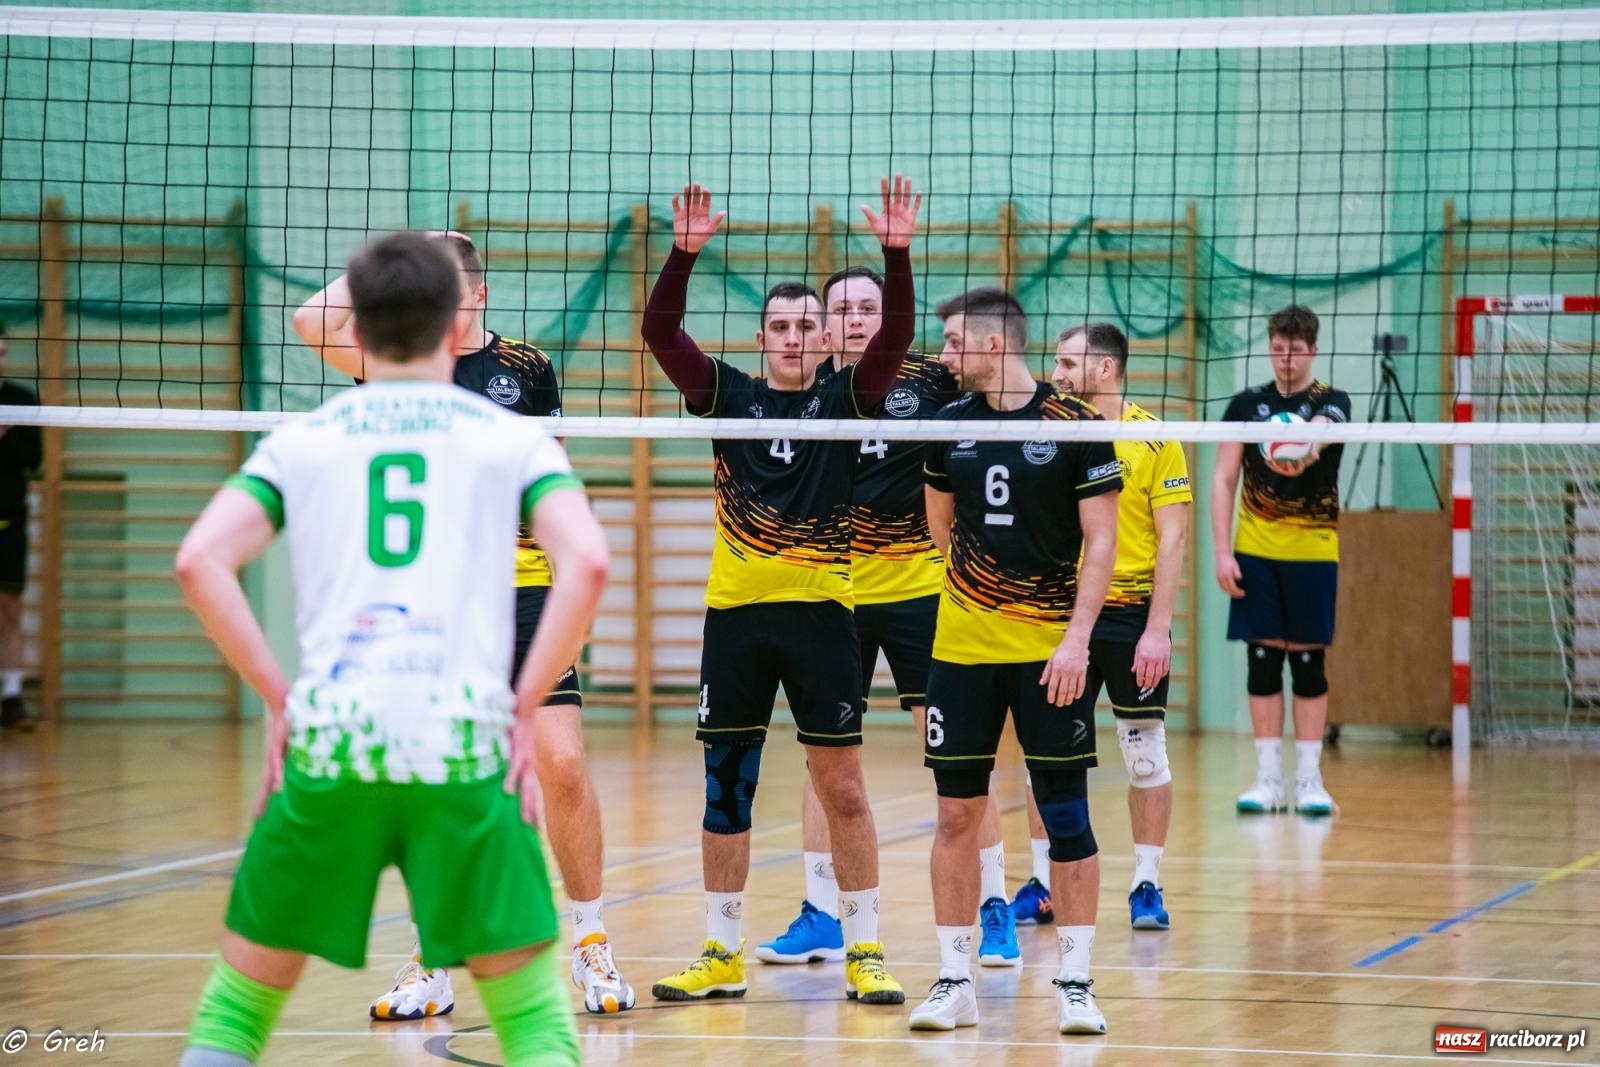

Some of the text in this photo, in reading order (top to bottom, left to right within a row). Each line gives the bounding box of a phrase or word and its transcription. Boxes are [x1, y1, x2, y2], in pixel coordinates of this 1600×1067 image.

[495, 386, 514, 394] TALENT
[892, 399, 913, 407] TALENT
[769, 438, 795, 464] 4
[860, 438, 889, 459] 4
[984, 464, 1011, 507] 6
[369, 452, 427, 568] 6
[926, 706, 945, 748] 6
